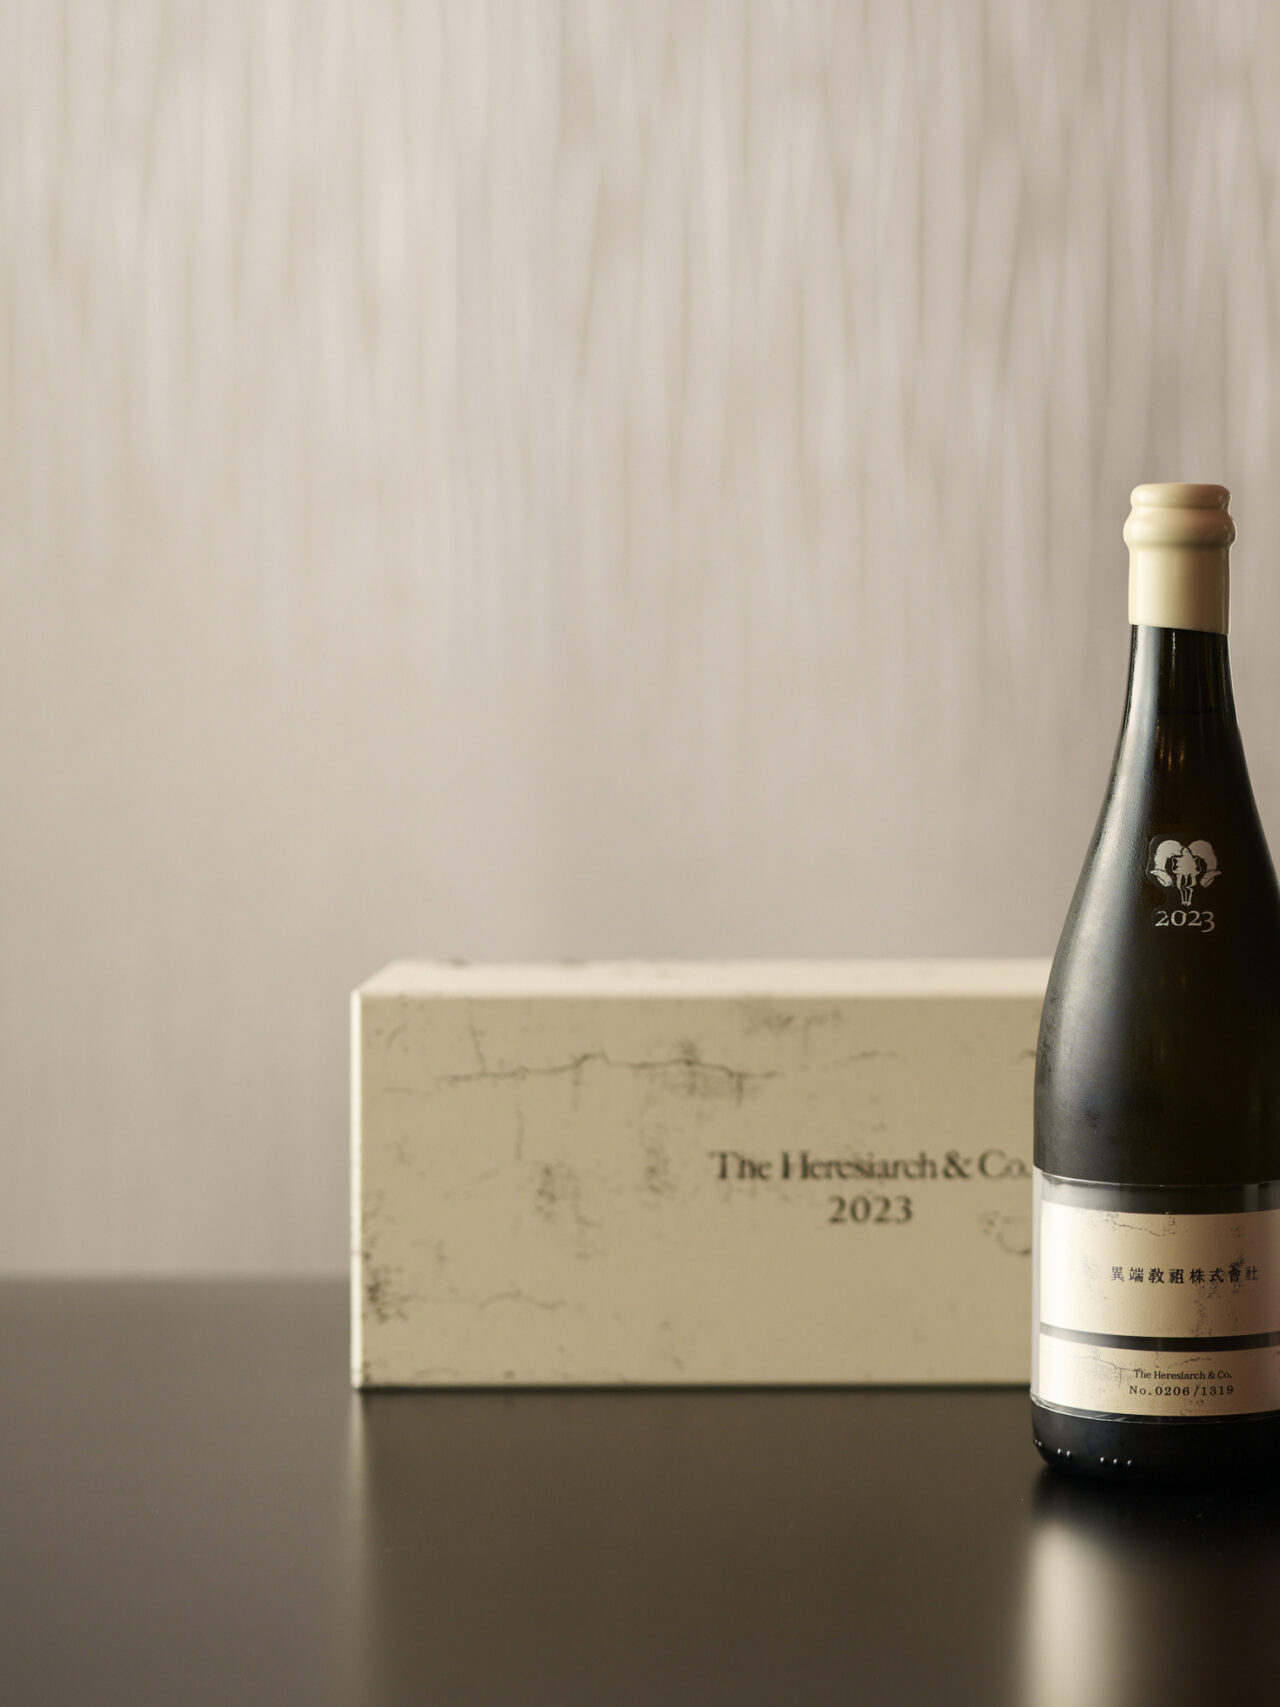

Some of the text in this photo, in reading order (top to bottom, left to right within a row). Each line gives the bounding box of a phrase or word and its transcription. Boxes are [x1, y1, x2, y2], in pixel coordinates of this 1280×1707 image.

[1154, 910, 1216, 933] 2023
[714, 1151, 772, 1181] The
[781, 1150, 937, 1181] Heresiarch
[943, 1151, 972, 1181] &
[828, 1195, 914, 1225] 2023
[1133, 1368, 1233, 1380] The Heresiarch & Co.
